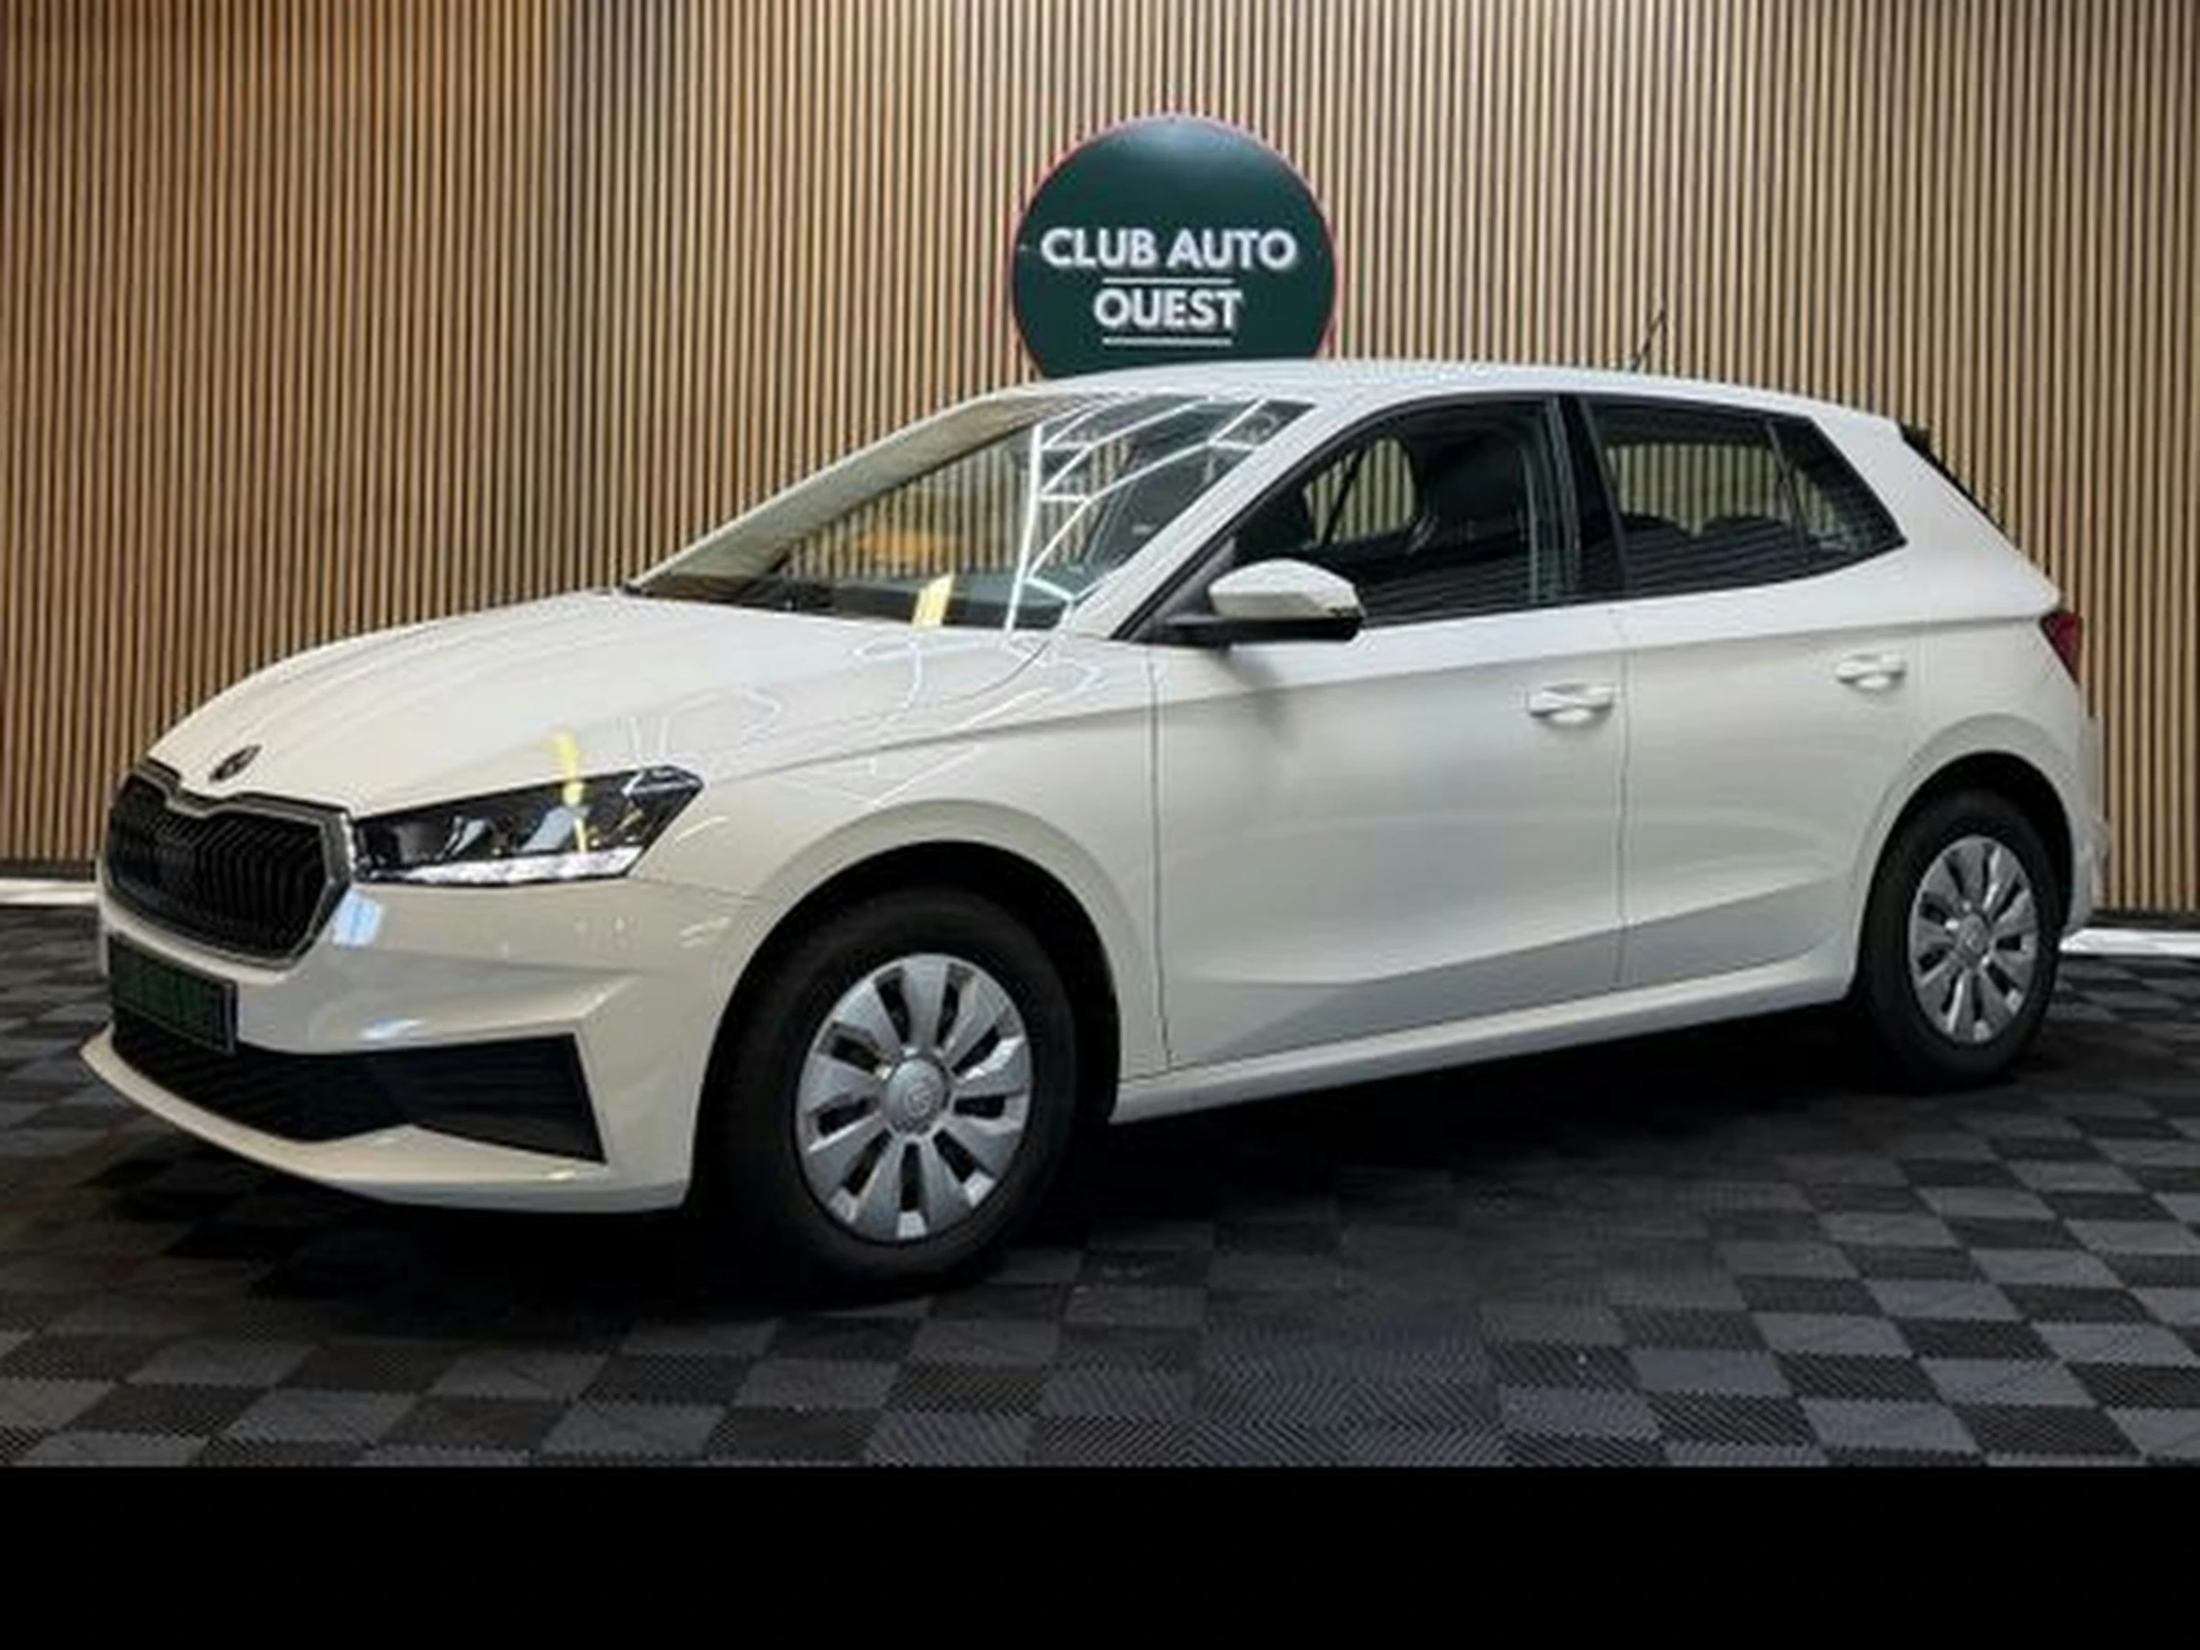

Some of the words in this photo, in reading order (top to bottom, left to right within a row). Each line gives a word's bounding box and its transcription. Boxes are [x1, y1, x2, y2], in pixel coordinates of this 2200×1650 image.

[1040, 227, 1157, 268] CLUB
[1166, 228, 1298, 270] AUTO
[1093, 288, 1242, 329] OUEST
